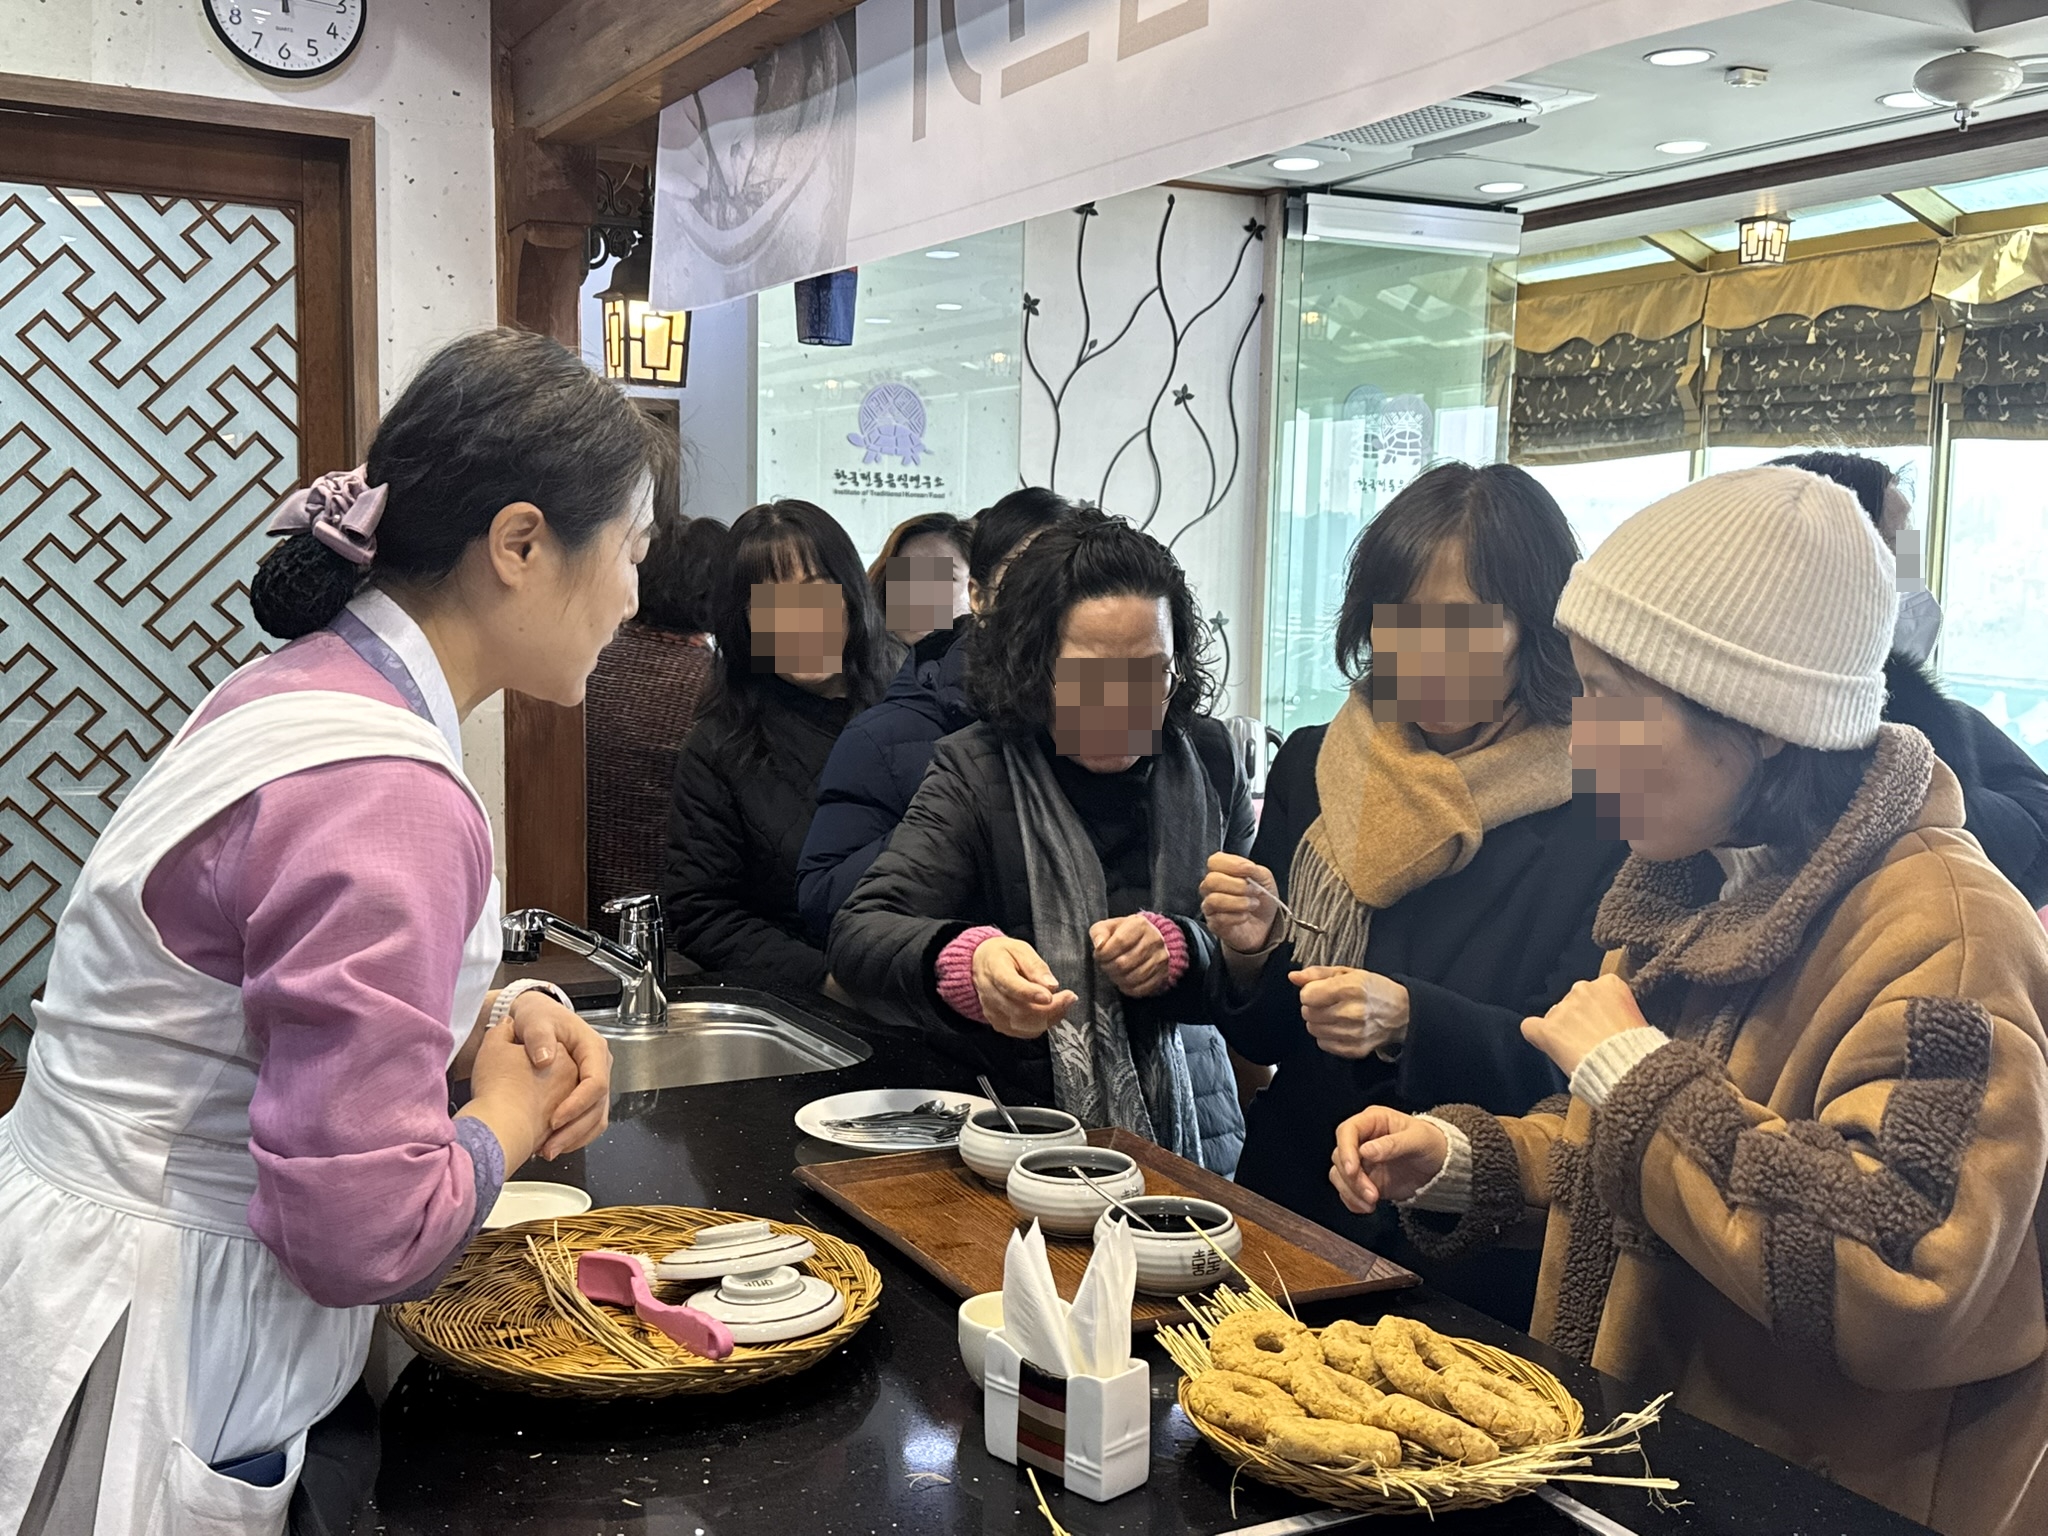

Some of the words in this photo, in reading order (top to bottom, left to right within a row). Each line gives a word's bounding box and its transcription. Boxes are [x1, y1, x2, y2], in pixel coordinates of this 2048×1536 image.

[335, 0, 347, 14] 3
[229, 8, 242, 25] 8
[251, 31, 263, 49] 7
[326, 22, 339, 40] 4
[278, 42, 291, 60] 6
[307, 38, 319, 57] 5
[833, 468, 945, 489] 한국전통음식연구소
